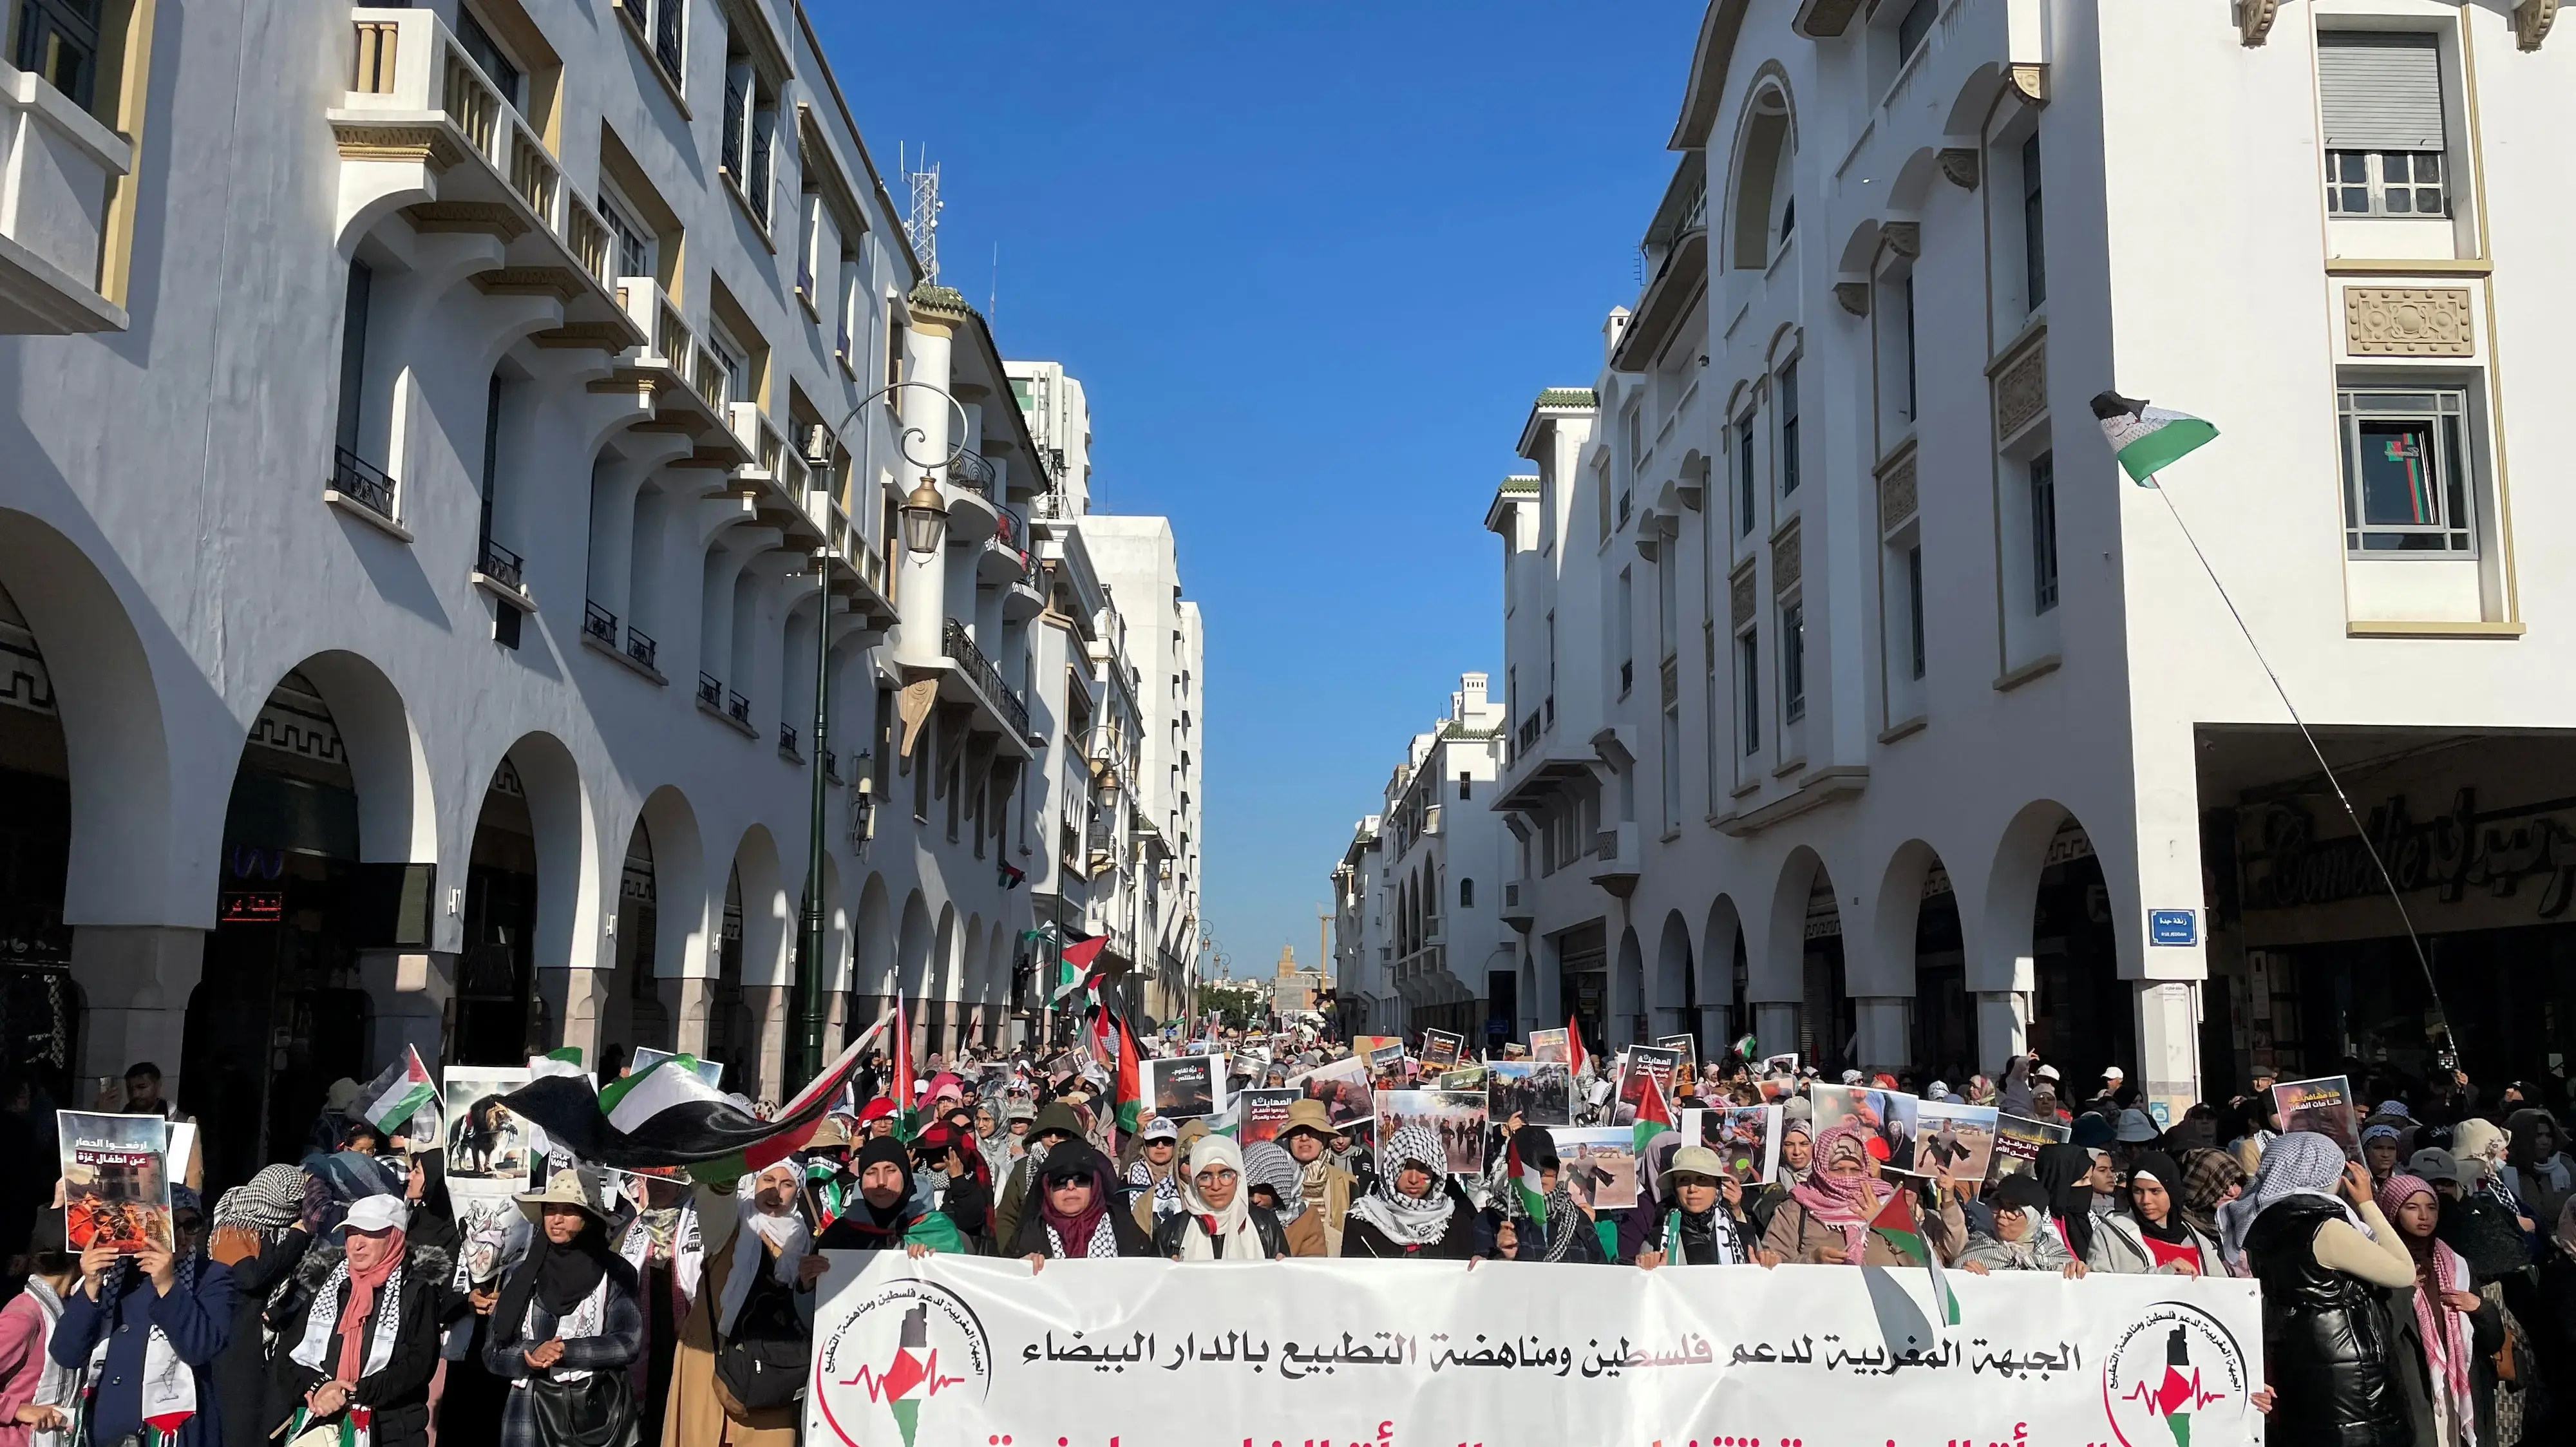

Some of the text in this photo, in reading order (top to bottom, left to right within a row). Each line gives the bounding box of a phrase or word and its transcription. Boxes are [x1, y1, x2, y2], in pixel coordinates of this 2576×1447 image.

[1251, 1097, 1292, 1108] الصهاينة
[75, 1137, 147, 1151] ارفعوا الحصار
[1998, 1137, 2031, 1150] الرضيع
[78, 1152, 146, 1166] عن اطفال غزة
[551, 1159, 568, 1169] WAR
[825, 1288, 984, 1376] الجبهة المغربية لدعم فلسطين ومناهضة التطبيع
[1022, 1329, 2080, 1382] الجبهة المغربية لدعم فلسطين ومناهضة التطبيع بالدار البيضاء
[2108, 1310, 2241, 1392] الجبهة المغربية لدعم فلسطين ومناهضة التطبيع
